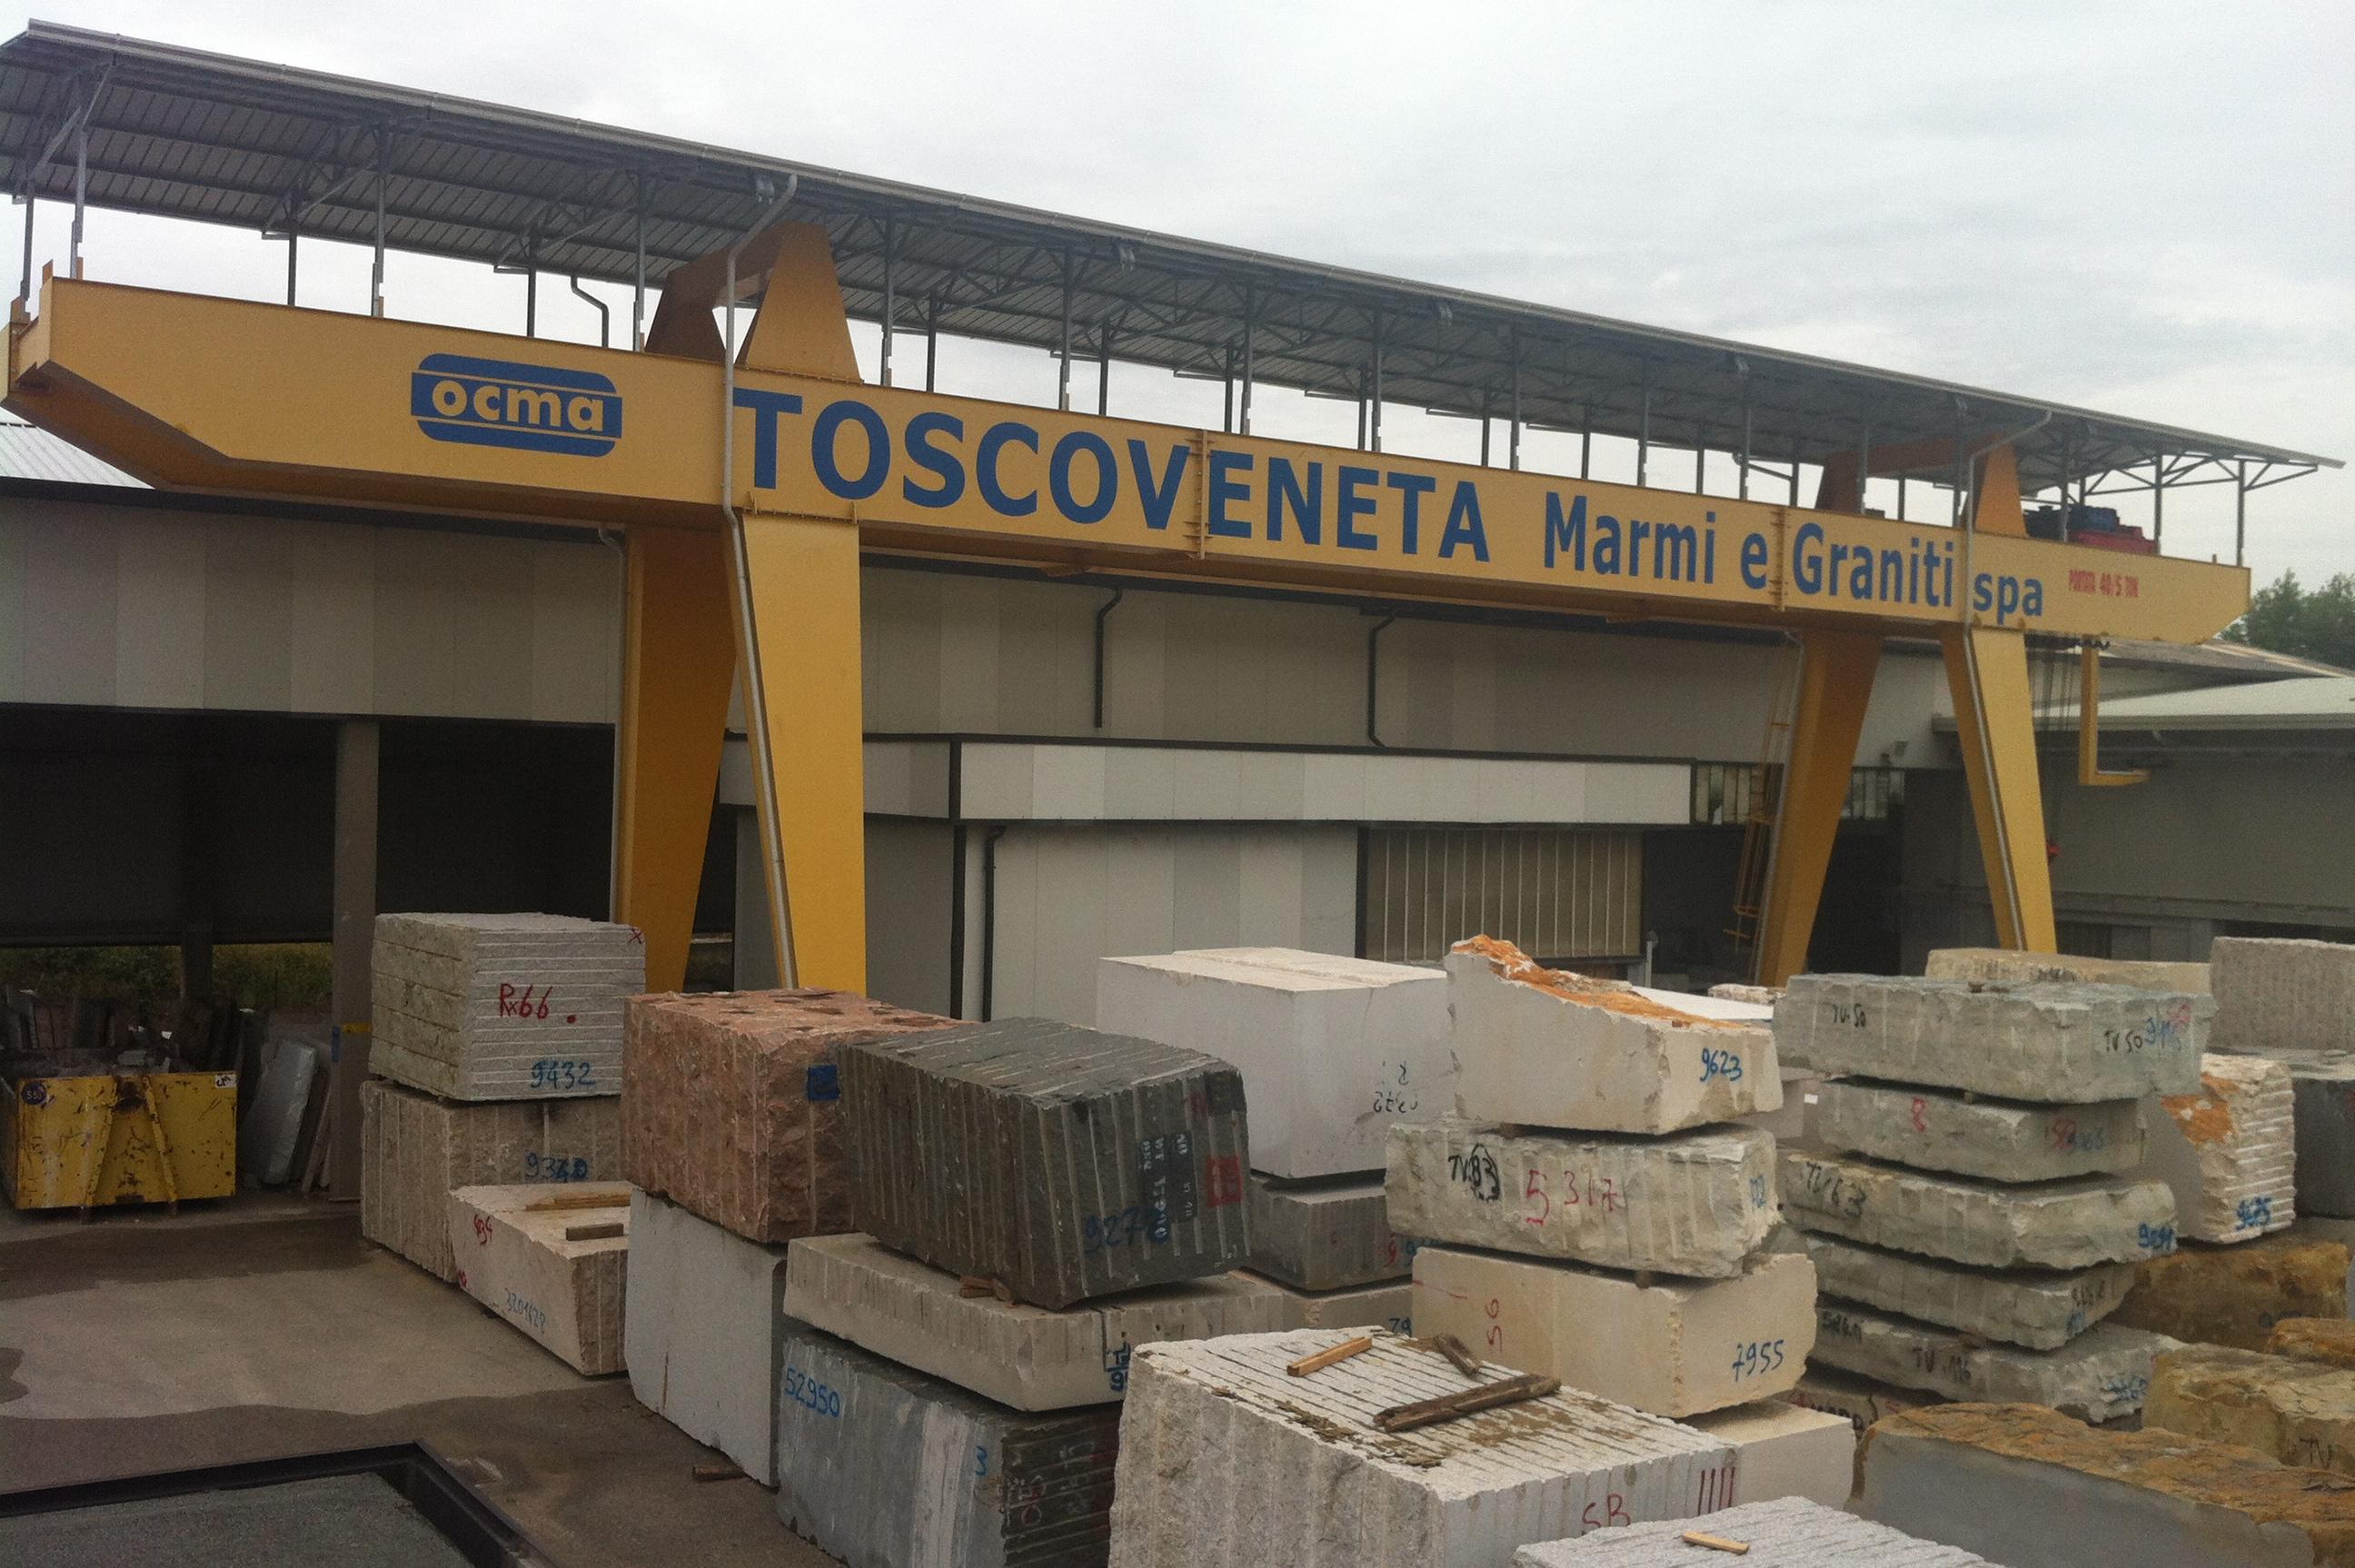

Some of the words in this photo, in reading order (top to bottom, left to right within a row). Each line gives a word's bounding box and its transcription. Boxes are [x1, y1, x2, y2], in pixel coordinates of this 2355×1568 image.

[431, 380, 605, 432] ocma
[730, 385, 1490, 563] TOSCOVENETA
[1545, 491, 1715, 586] Marmi
[1741, 530, 1769, 590] e
[1791, 523, 1953, 608] Graniti
[1972, 570, 2044, 623] spa
[530, 1060, 596, 1089] 9432
[1699, 1047, 1744, 1082] 9623
[1732, 1338, 1785, 1383] 7955
[784, 1366, 841, 1418] 52950
